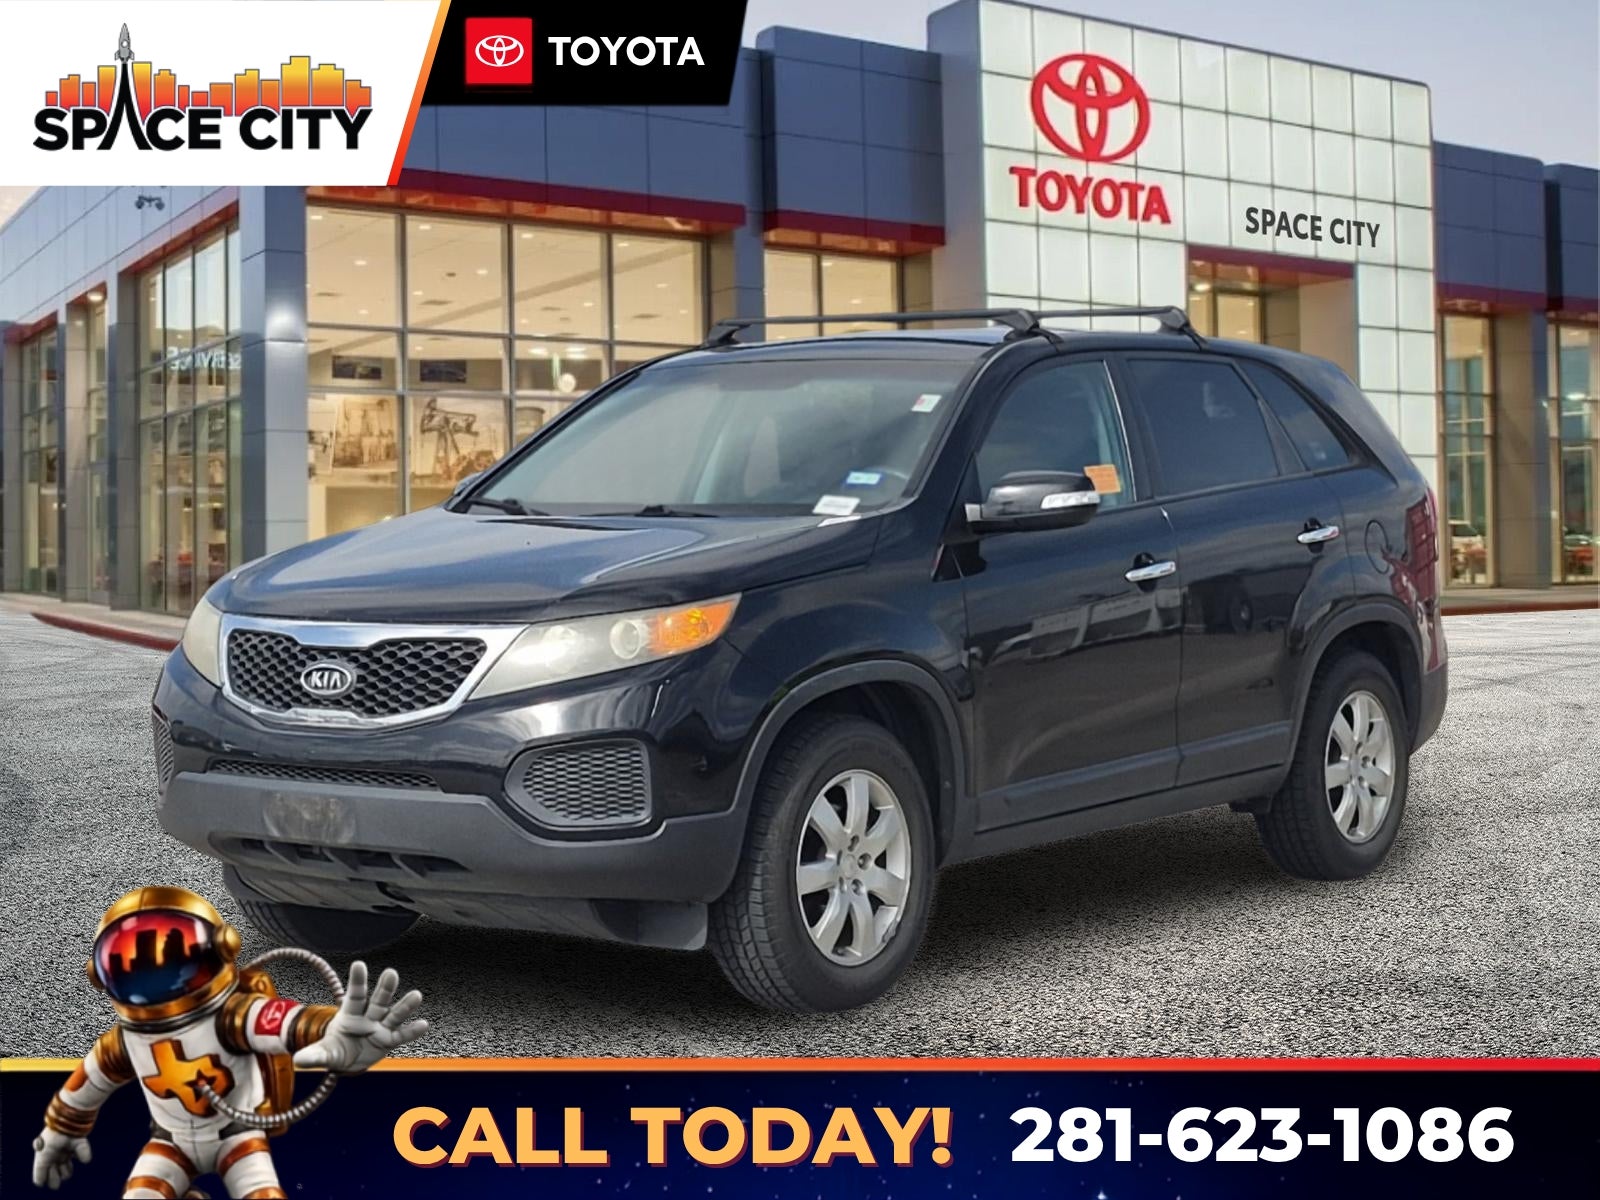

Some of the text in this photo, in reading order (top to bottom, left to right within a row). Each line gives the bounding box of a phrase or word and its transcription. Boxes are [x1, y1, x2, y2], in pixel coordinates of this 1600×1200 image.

[1009, 166, 1171, 224] TOYOTA
[1245, 206, 1381, 248] SPACE CITY
[311, 671, 342, 689] KIA
